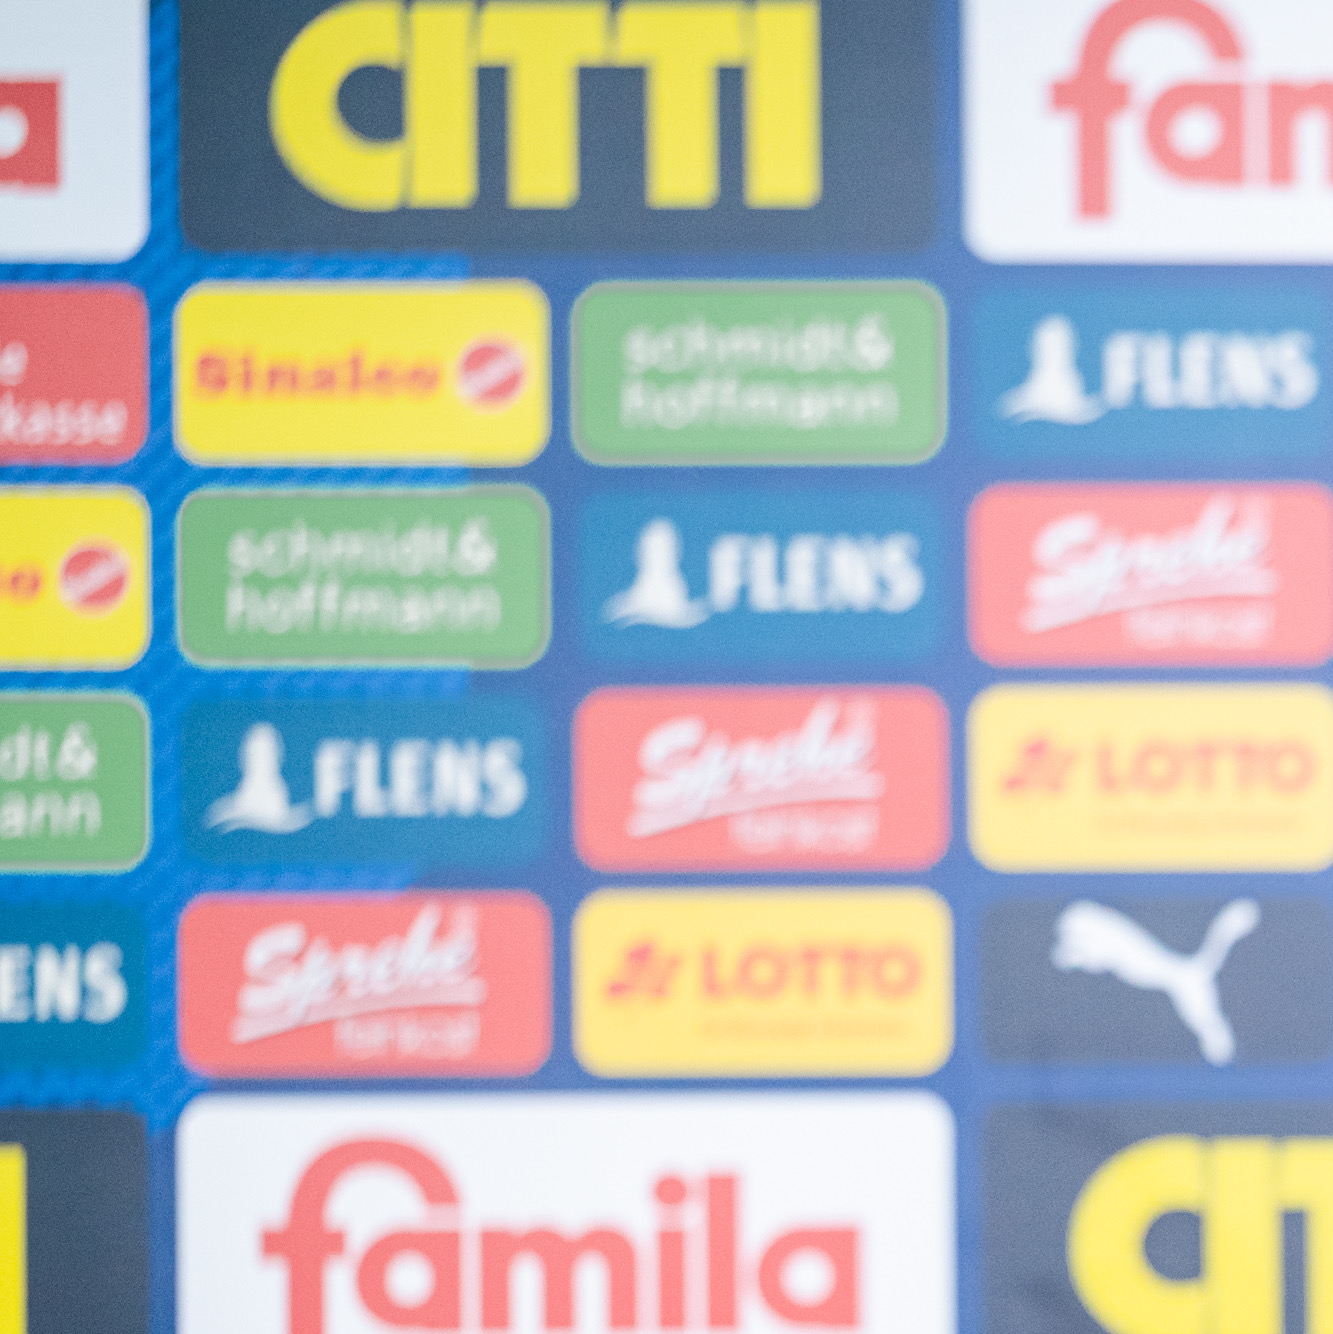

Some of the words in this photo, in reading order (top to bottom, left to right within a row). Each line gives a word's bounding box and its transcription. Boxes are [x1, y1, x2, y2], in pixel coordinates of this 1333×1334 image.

[270, 0, 822, 212] CITTI
[1104, 329, 1320, 410] FLENS
[709, 532, 924, 613] FLENS
[314, 737, 527, 820] FLENS
[1095, 736, 1318, 796] LOTTO
[700, 940, 924, 1000] LOTTO
